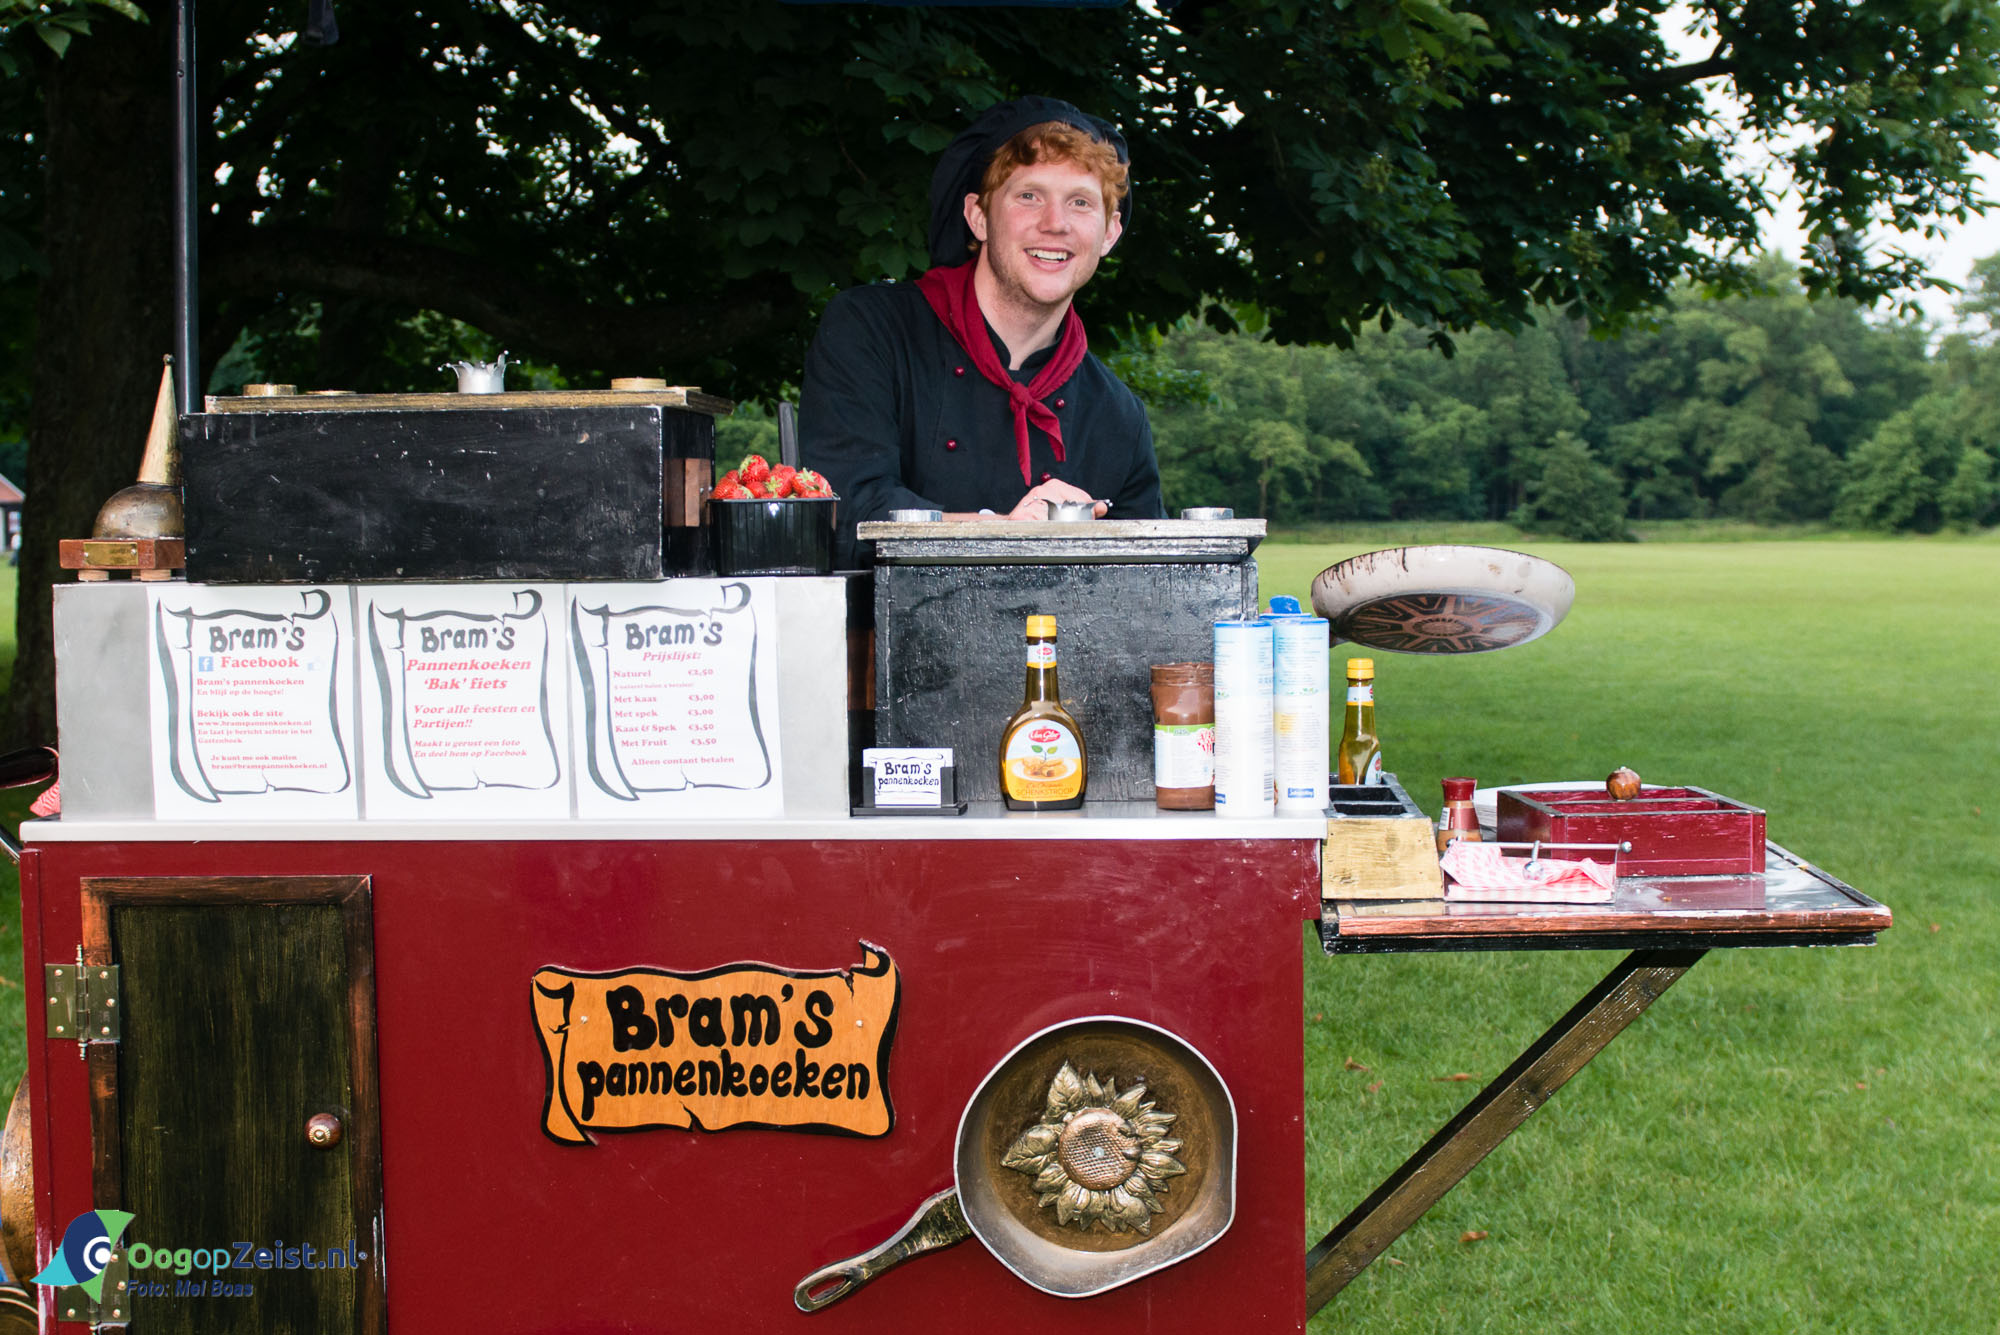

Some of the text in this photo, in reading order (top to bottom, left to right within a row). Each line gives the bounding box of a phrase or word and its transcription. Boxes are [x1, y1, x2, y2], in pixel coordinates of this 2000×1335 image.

[209, 626, 304, 652] Bram's
[421, 626, 515, 652] Bram's
[625, 622, 722, 650] Bram's
[221, 656, 299, 668] Facebook
[643, 651, 701, 662] Prijslijst:
[406, 659, 532, 671] Pannenkoeken
[614, 670, 651, 678] Naturel
[234, 679, 304, 687] pannenkoeken
[469, 678, 507, 689] fiets
[197, 710, 229, 719] Bekijk
[414, 705, 535, 714] Voor alle feesten en
[635, 709, 658, 718] spek
[414, 719, 473, 729] Partijen!!
[652, 724, 676, 733] Spek
[453, 740, 482, 748] gerust
[632, 758, 660, 766] Alleen
[885, 762, 931, 775] Bram's
[878, 776, 939, 789] pannenkoeken
[606, 983, 833, 1052] Bram's
[577, 1048, 870, 1121] pannenkoeken
